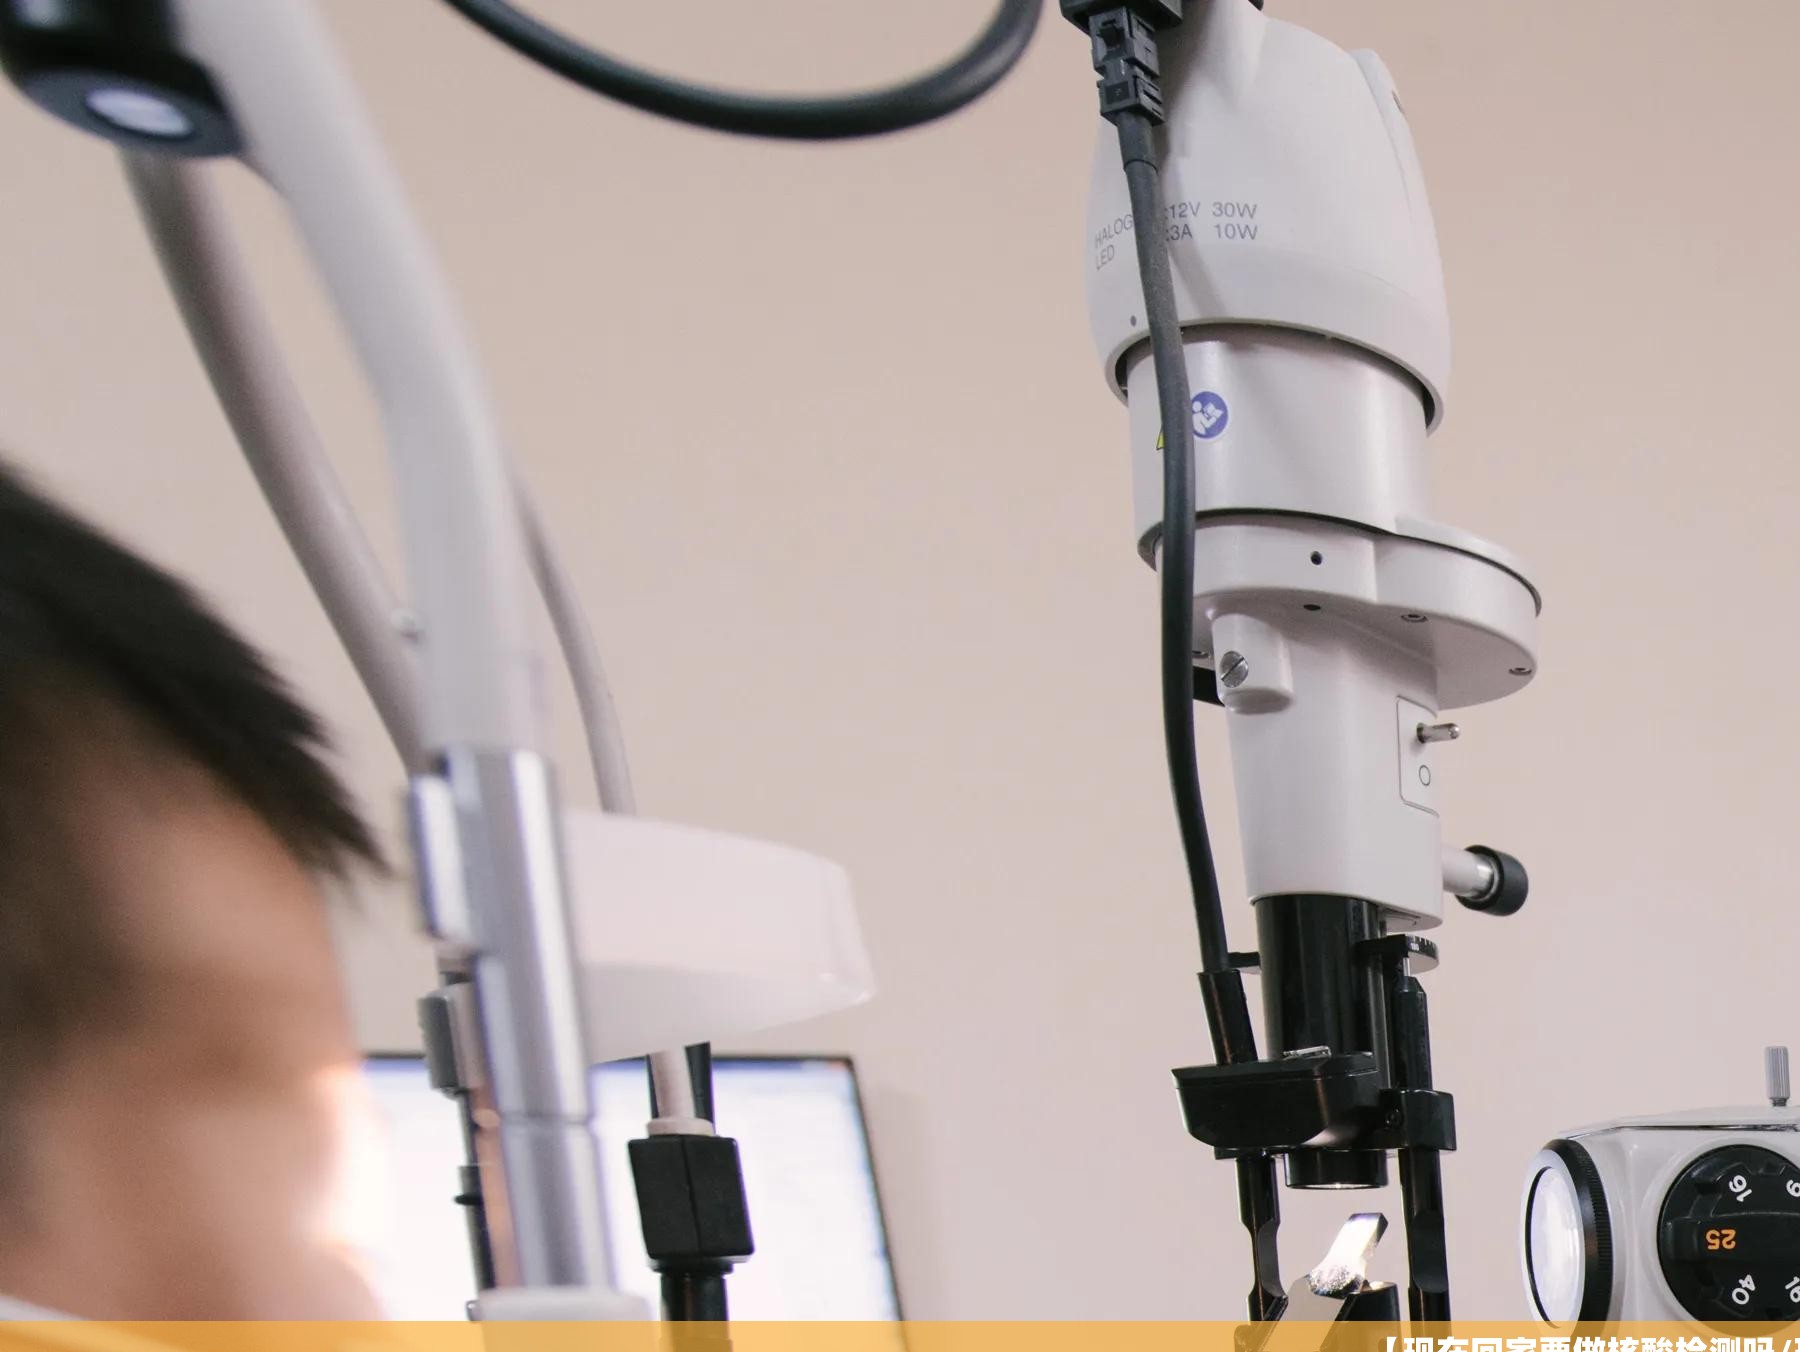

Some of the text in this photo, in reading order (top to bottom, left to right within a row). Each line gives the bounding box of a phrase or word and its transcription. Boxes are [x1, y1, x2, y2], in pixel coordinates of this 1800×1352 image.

[1095, 213, 1134, 249] HALOG
[1212, 202, 1258, 219] 30W
[1096, 244, 1115, 271] LED
[1214, 223, 1258, 240] 10W
[1705, 1229, 1737, 1250] 25
[1731, 1274, 1756, 1305] 40
